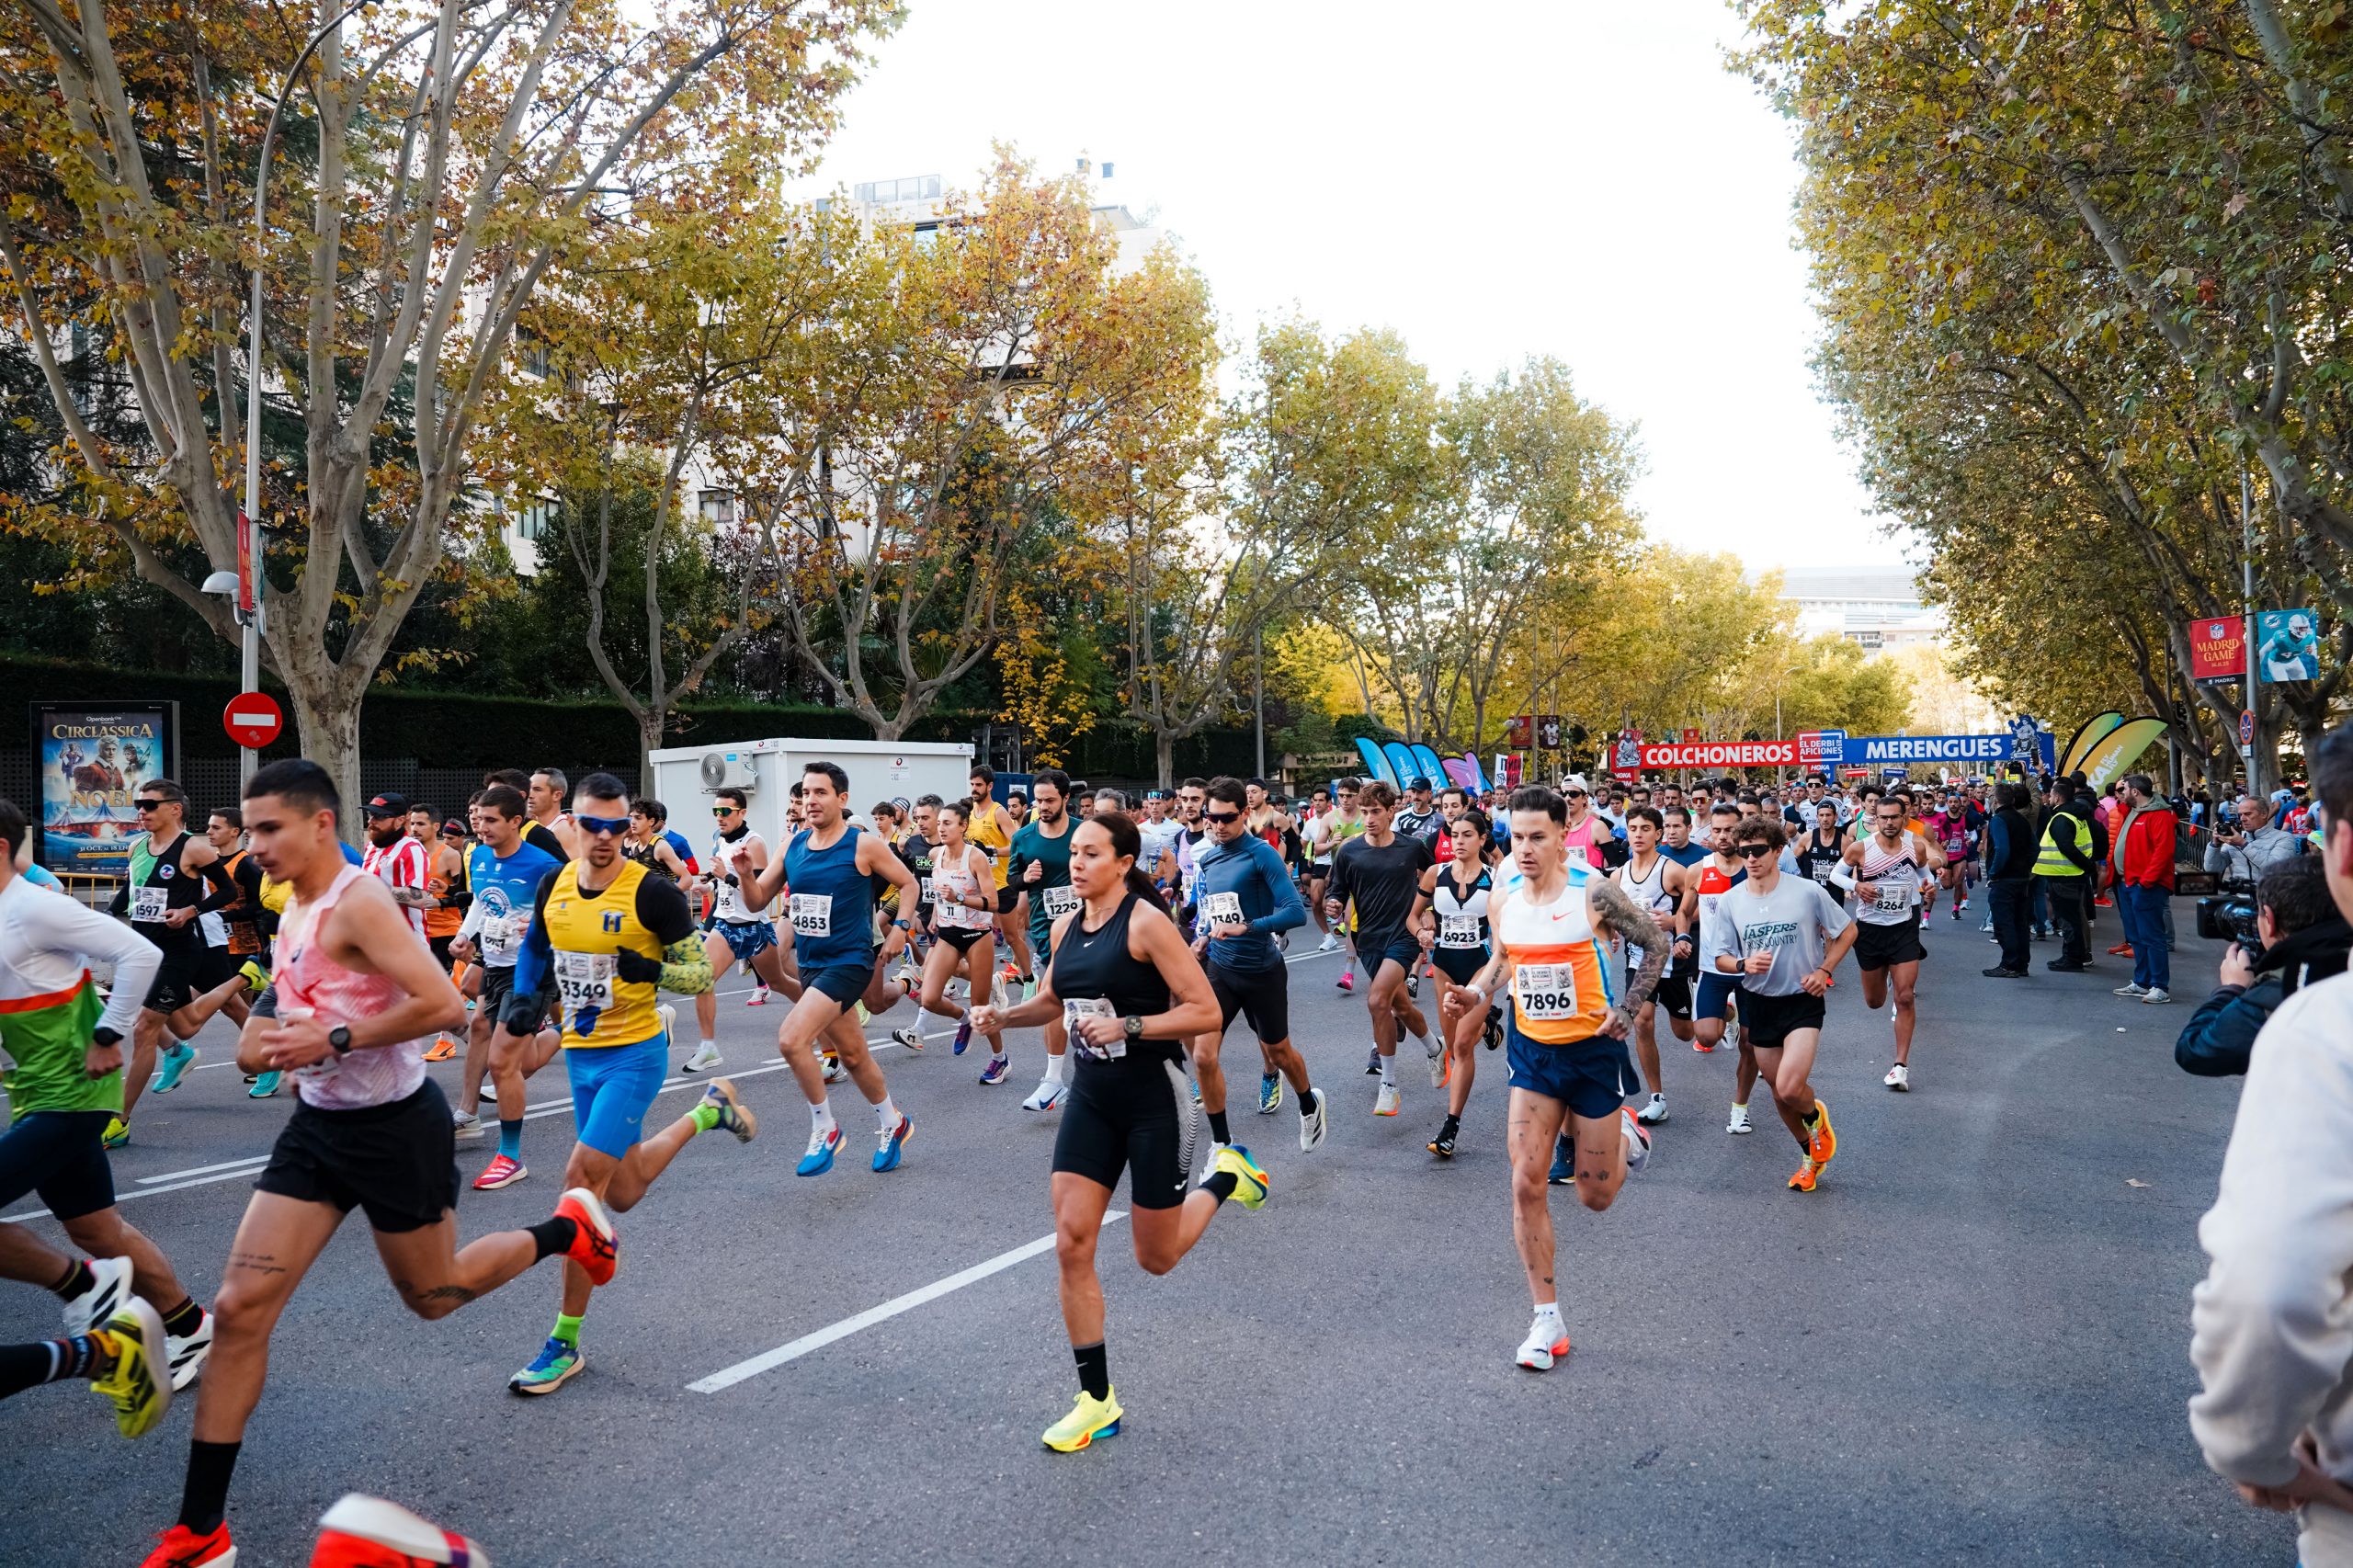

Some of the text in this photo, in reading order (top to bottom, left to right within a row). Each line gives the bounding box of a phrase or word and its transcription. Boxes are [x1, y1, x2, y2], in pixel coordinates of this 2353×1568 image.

[2197, 638, 2240, 653] MADRID
[2203, 649, 2235, 662] GAME
[52, 723, 154, 739] CIRCLASSICA
[1799, 739, 1835, 748] EL DERBI
[1800, 746, 1843, 756] AFICIONES
[1866, 738, 2003, 759] MERENGUES
[1645, 744, 1793, 765] COLCHONEROS
[136, 904, 160, 916] 1597
[947, 906, 954, 916] 11
[1876, 900, 1904, 911] 8264
[792, 915, 826, 930] 4853
[1444, 931, 1476, 943] 6923
[1743, 922, 1798, 941] JASPERS
[561, 979, 607, 999] 3349
[1522, 992, 1571, 1010] 7896
